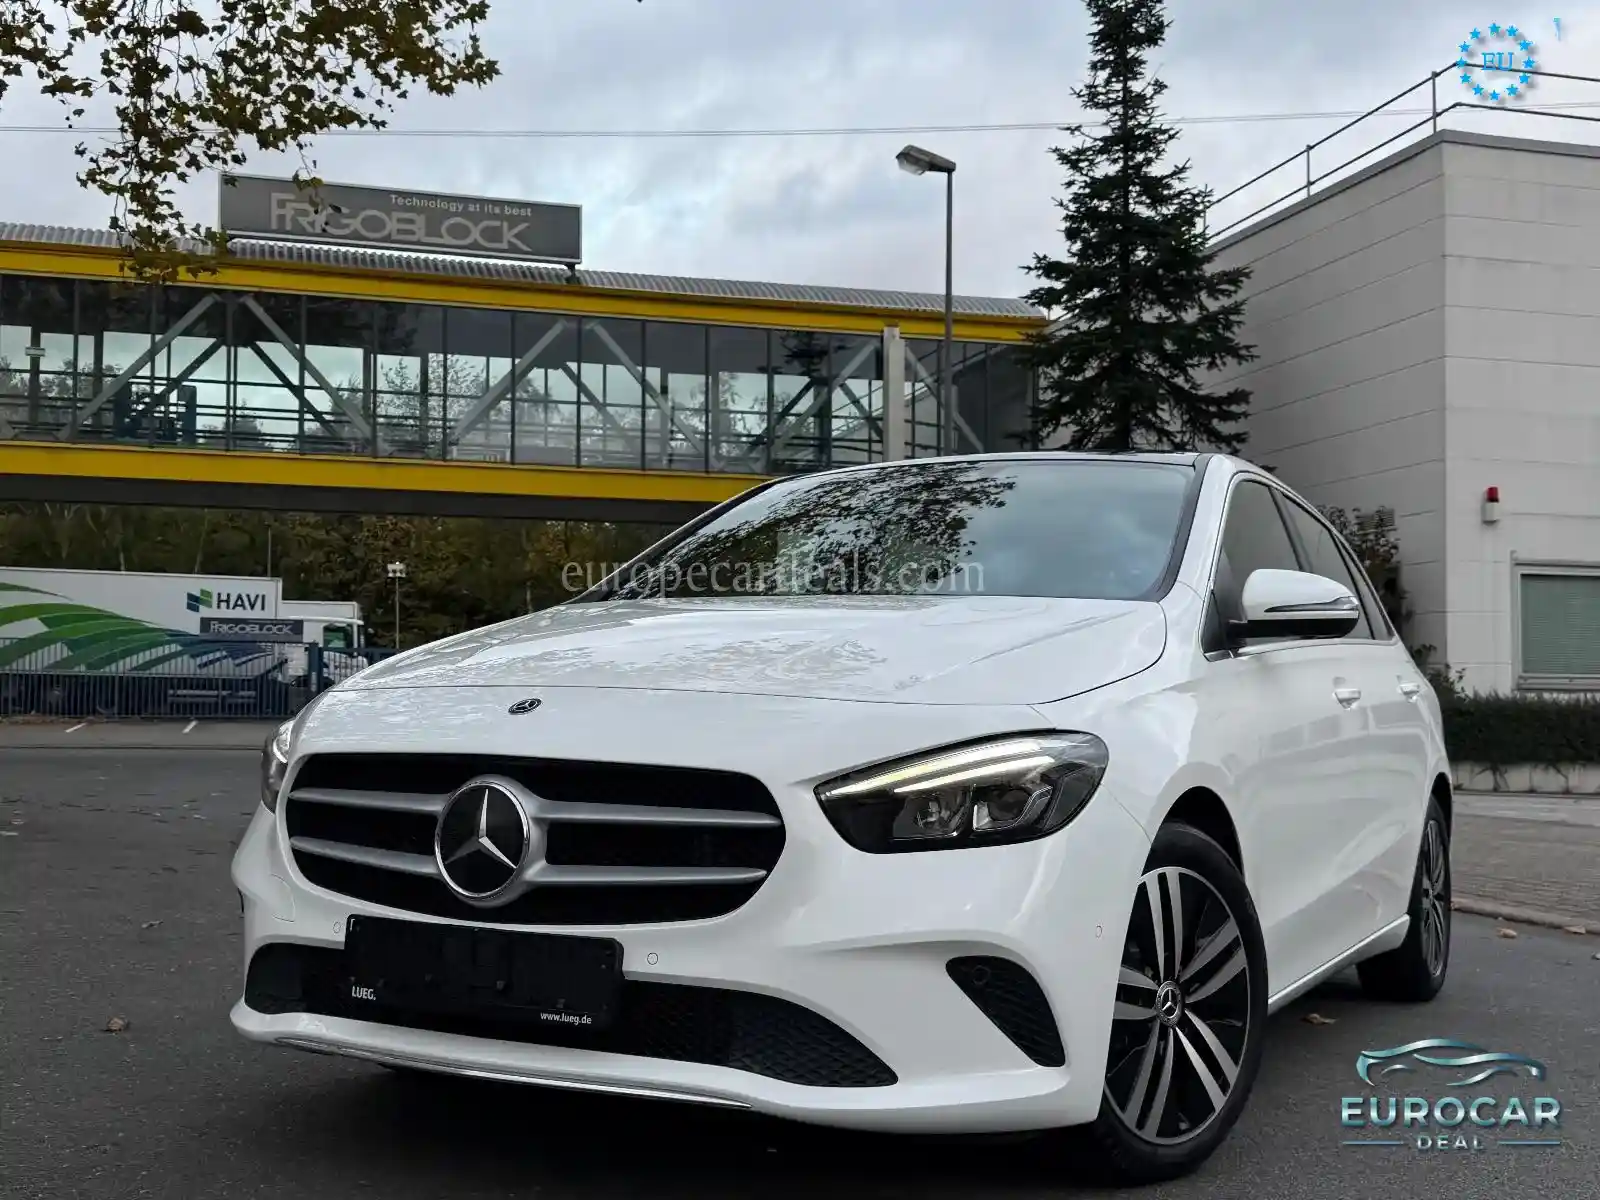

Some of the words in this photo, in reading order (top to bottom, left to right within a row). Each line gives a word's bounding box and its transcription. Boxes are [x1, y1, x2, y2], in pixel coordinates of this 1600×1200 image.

[390, 194, 464, 212] Technology
[468, 202, 480, 212] at
[484, 203, 500, 214] its
[504, 205, 532, 217] best
[271, 192, 533, 251] FRIGOBLOCK
[217, 593, 266, 611] HAVI
[209, 621, 294, 635] FRIGOBLOCK
[351, 985, 377, 1001] LUEG.
[540, 1011, 592, 1026] www.lueg.de
